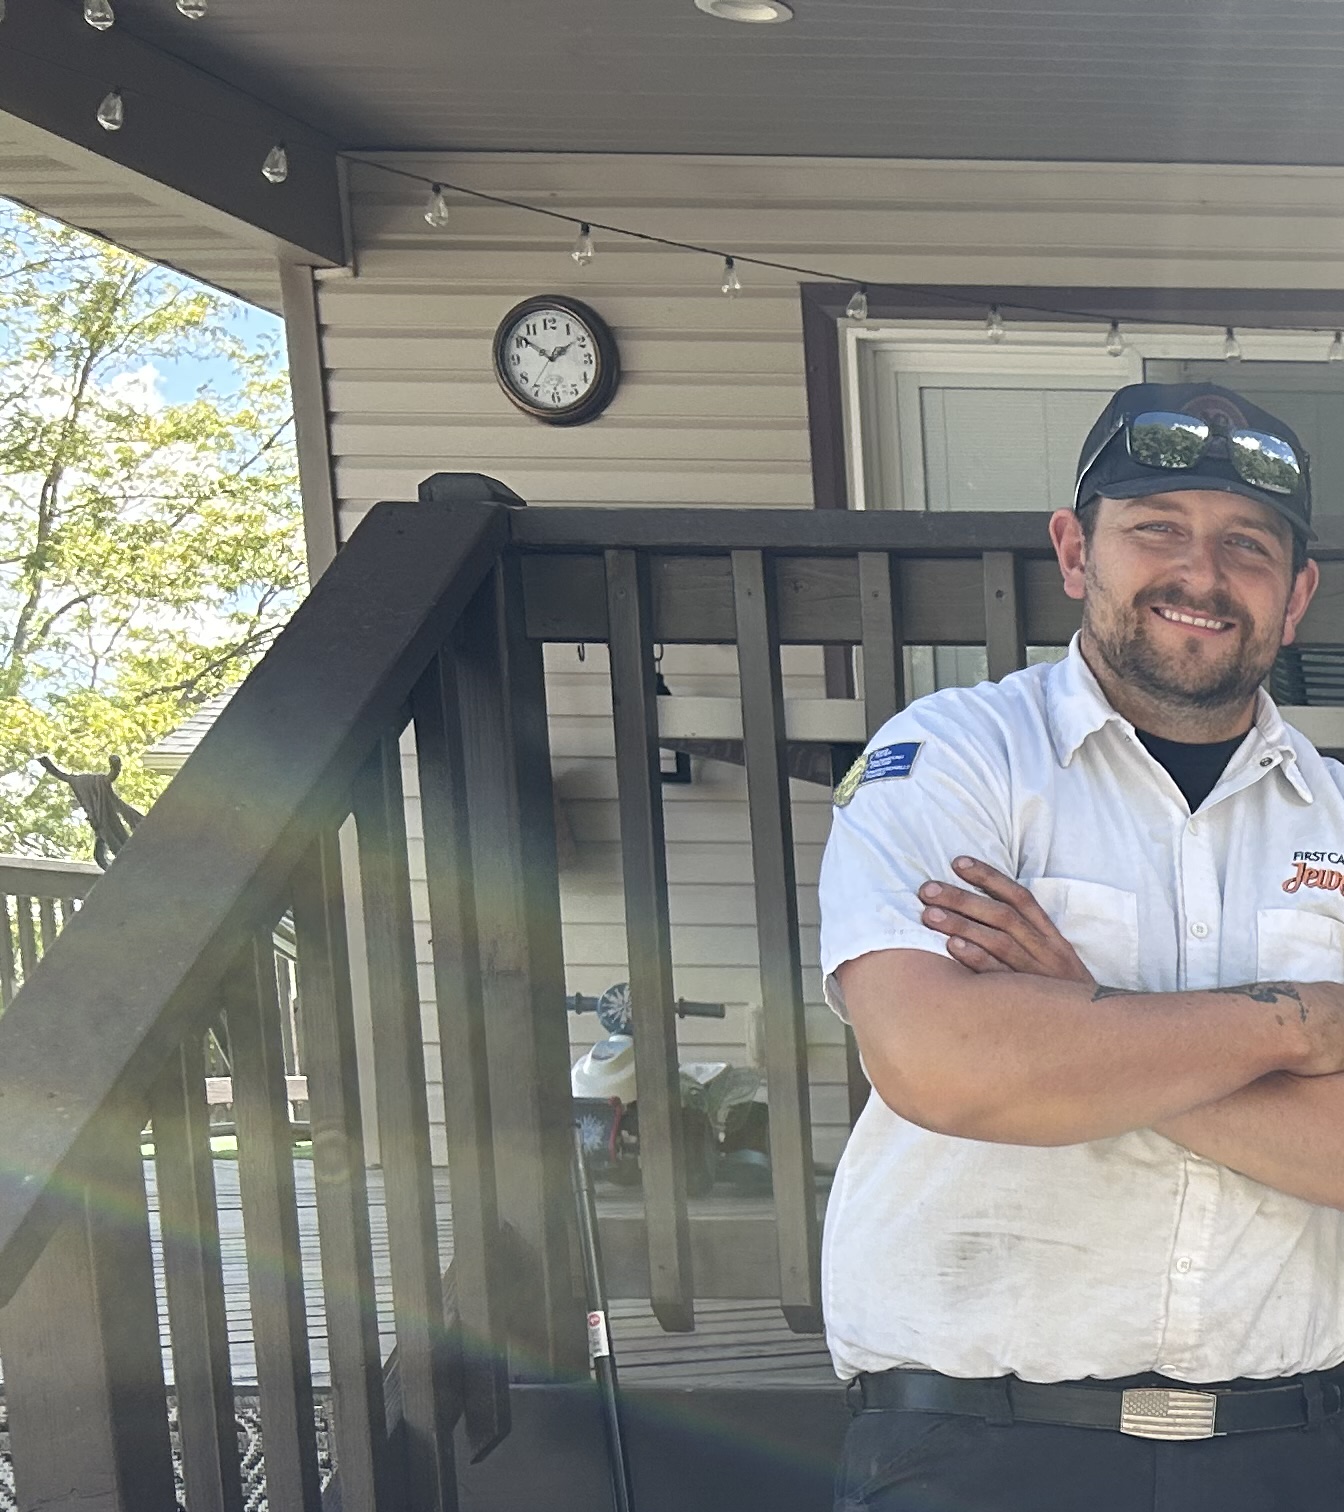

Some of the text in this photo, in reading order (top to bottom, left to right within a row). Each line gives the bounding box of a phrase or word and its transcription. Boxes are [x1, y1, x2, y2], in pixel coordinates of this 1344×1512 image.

[526, 323, 537, 336] 11
[543, 317, 557, 331] 12
[516, 336, 529, 348] 10
[577, 335, 586, 349] 2
[511, 353, 520, 366] 9
[583, 352, 593, 365] 3
[520, 371, 529, 385] 8
[532, 383, 540, 397] 7
[569, 383, 579, 397] 5
[552, 391, 561, 403] 6
[1293, 851, 1327, 863] FIRST
